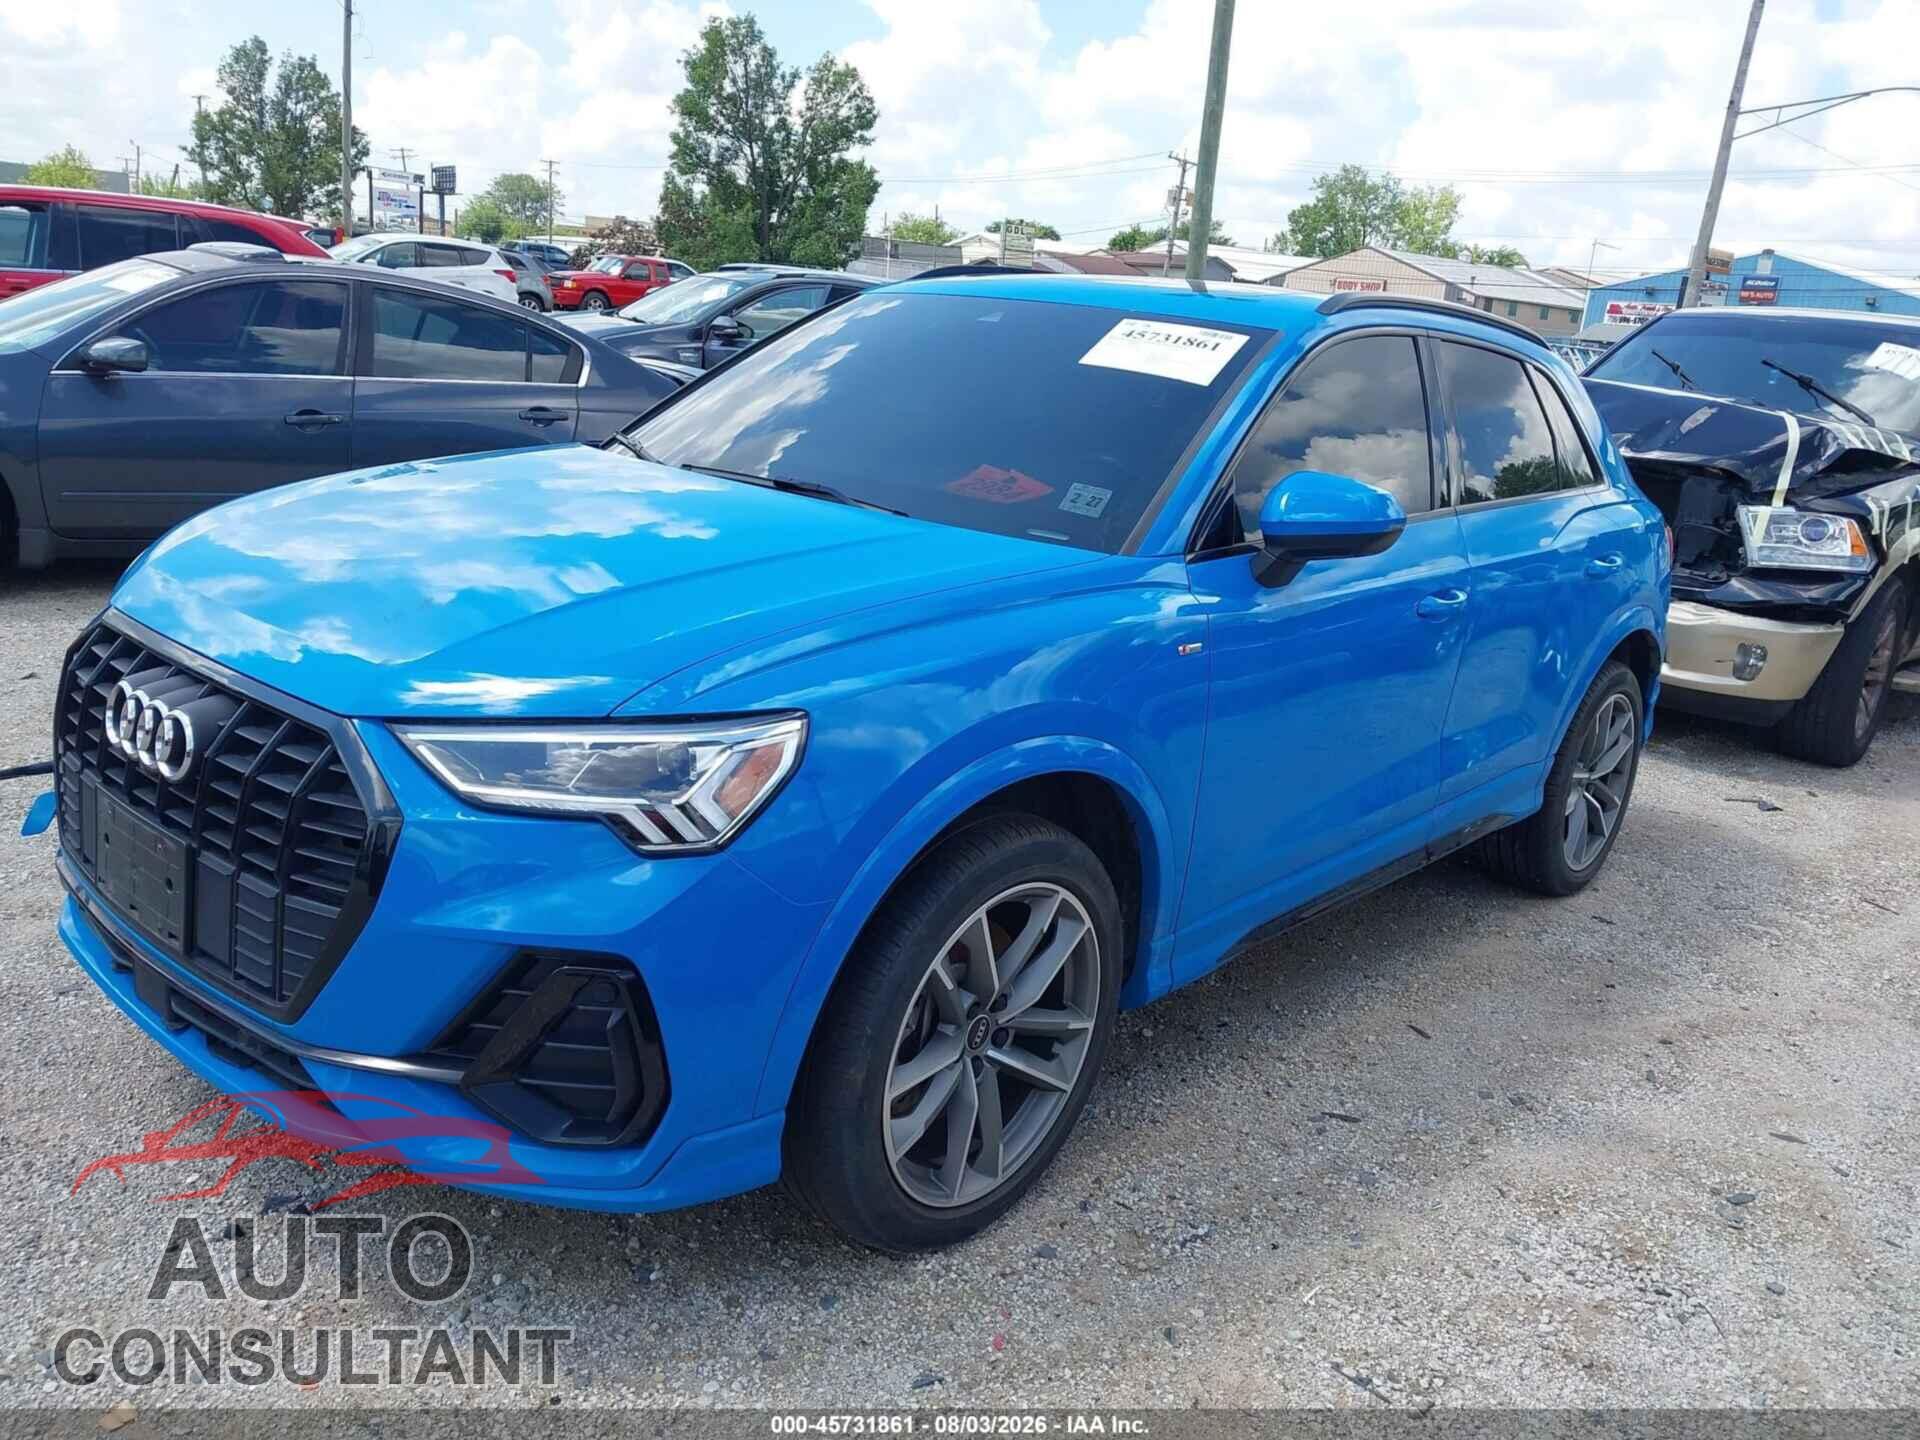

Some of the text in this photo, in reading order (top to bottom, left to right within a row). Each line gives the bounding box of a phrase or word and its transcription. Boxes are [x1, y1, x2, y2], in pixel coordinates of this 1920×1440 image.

[1337, 281, 1357, 290] BODY
[1121, 329, 1221, 351] 45731861
[1070, 492, 1081, 504] 2
[1086, 495, 1105, 509] 27
